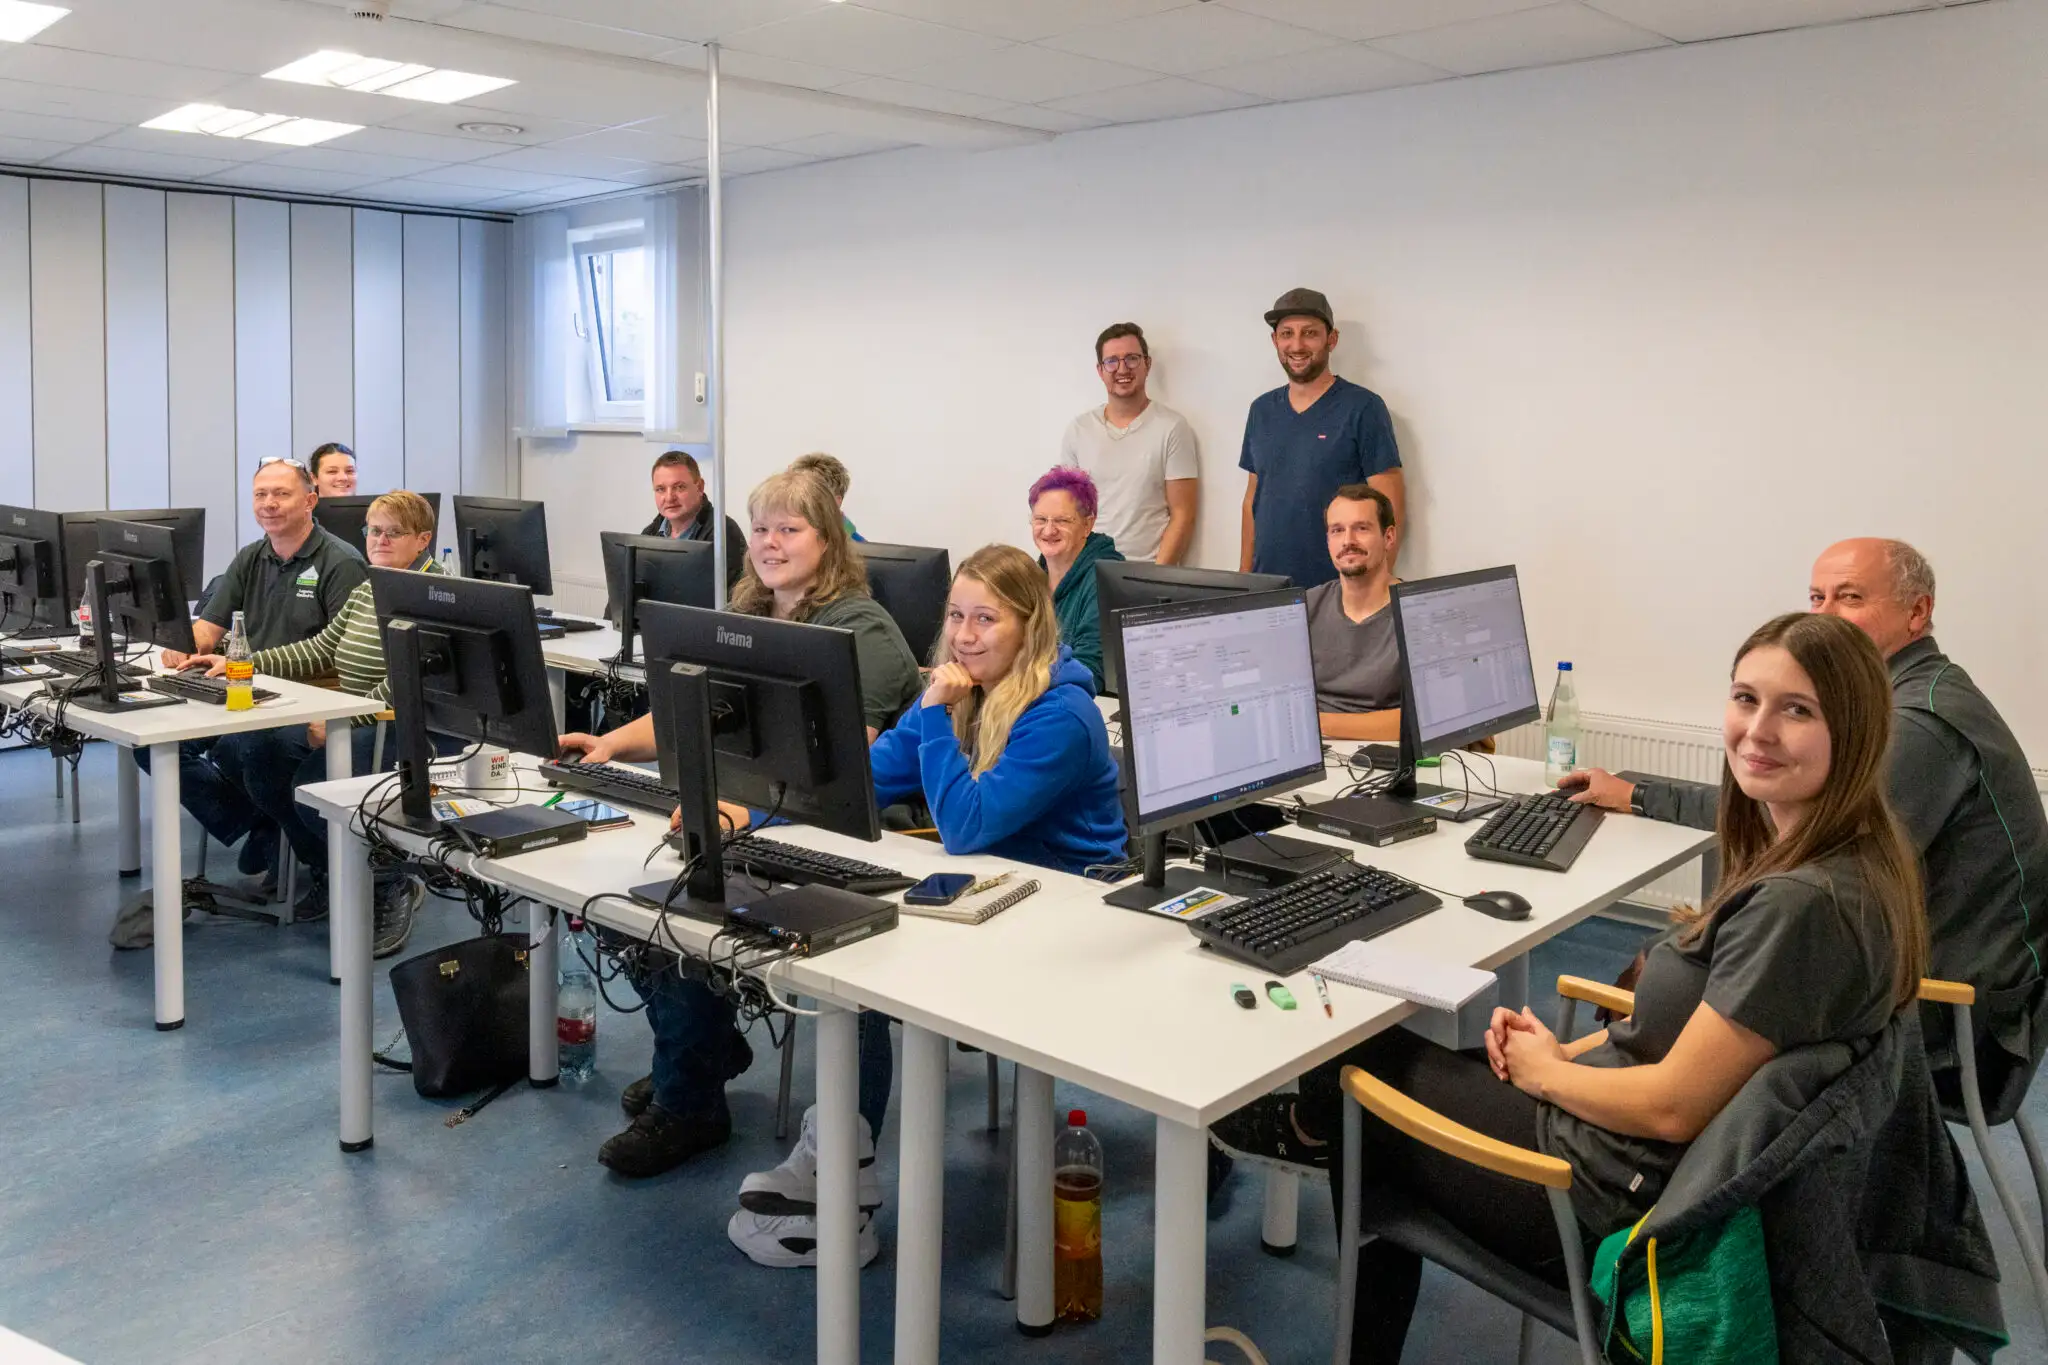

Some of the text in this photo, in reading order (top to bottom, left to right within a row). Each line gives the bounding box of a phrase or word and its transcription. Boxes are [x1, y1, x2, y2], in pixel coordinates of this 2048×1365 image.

[428, 585, 456, 604] iiyama
[716, 625, 753, 649] iiyama
[491, 756, 505, 764] WIR
